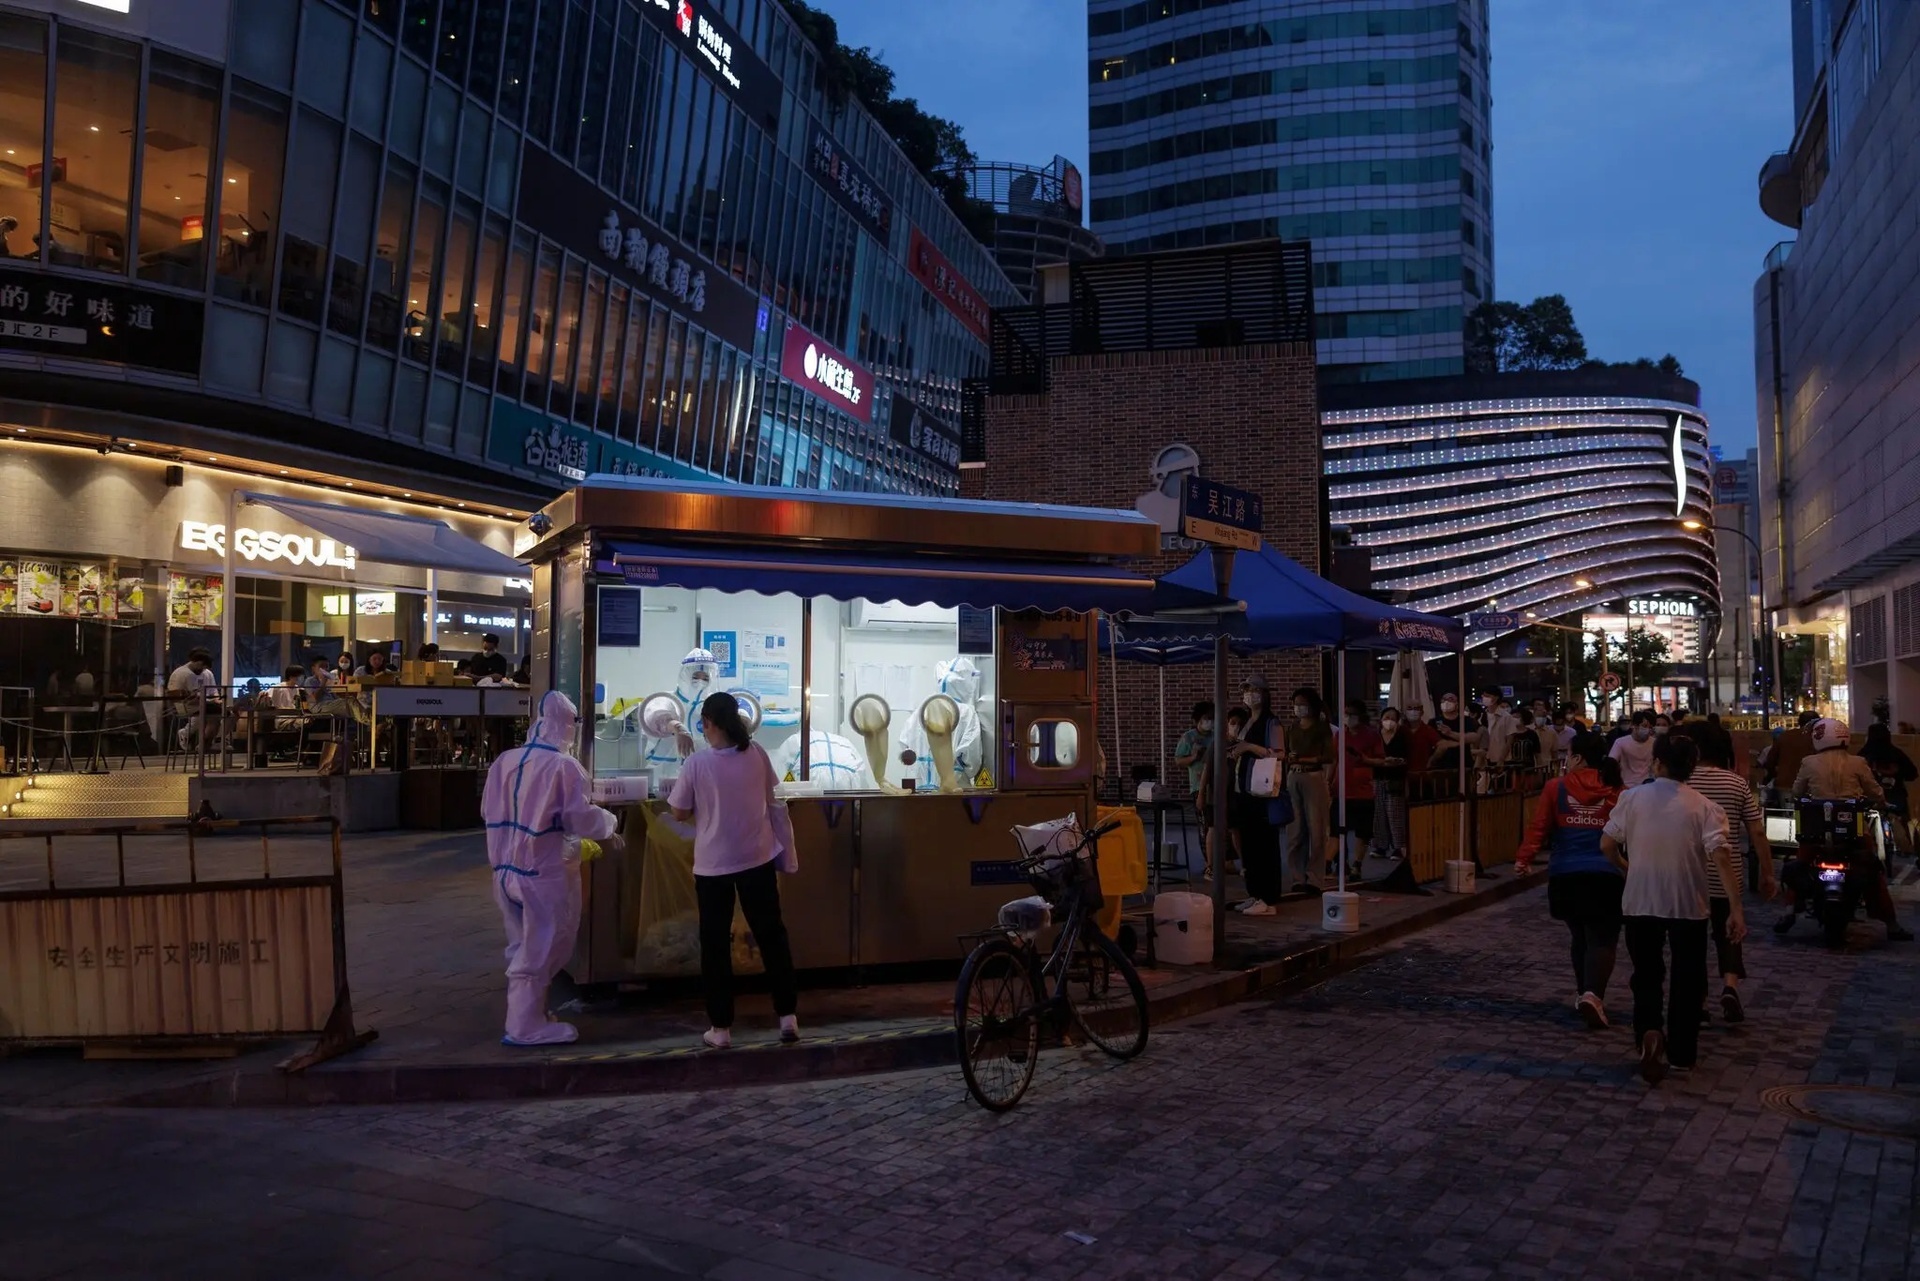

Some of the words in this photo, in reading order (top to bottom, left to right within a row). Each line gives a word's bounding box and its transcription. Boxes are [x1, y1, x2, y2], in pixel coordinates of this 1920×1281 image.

[1208, 489, 1246, 522] 吴江路
[181, 520, 347, 567] EGGSOUL
[1628, 600, 1695, 616] SEPHORA
[1566, 814, 1606, 826] adidas
[48, 939, 270, 969] 安全生产文明施工
